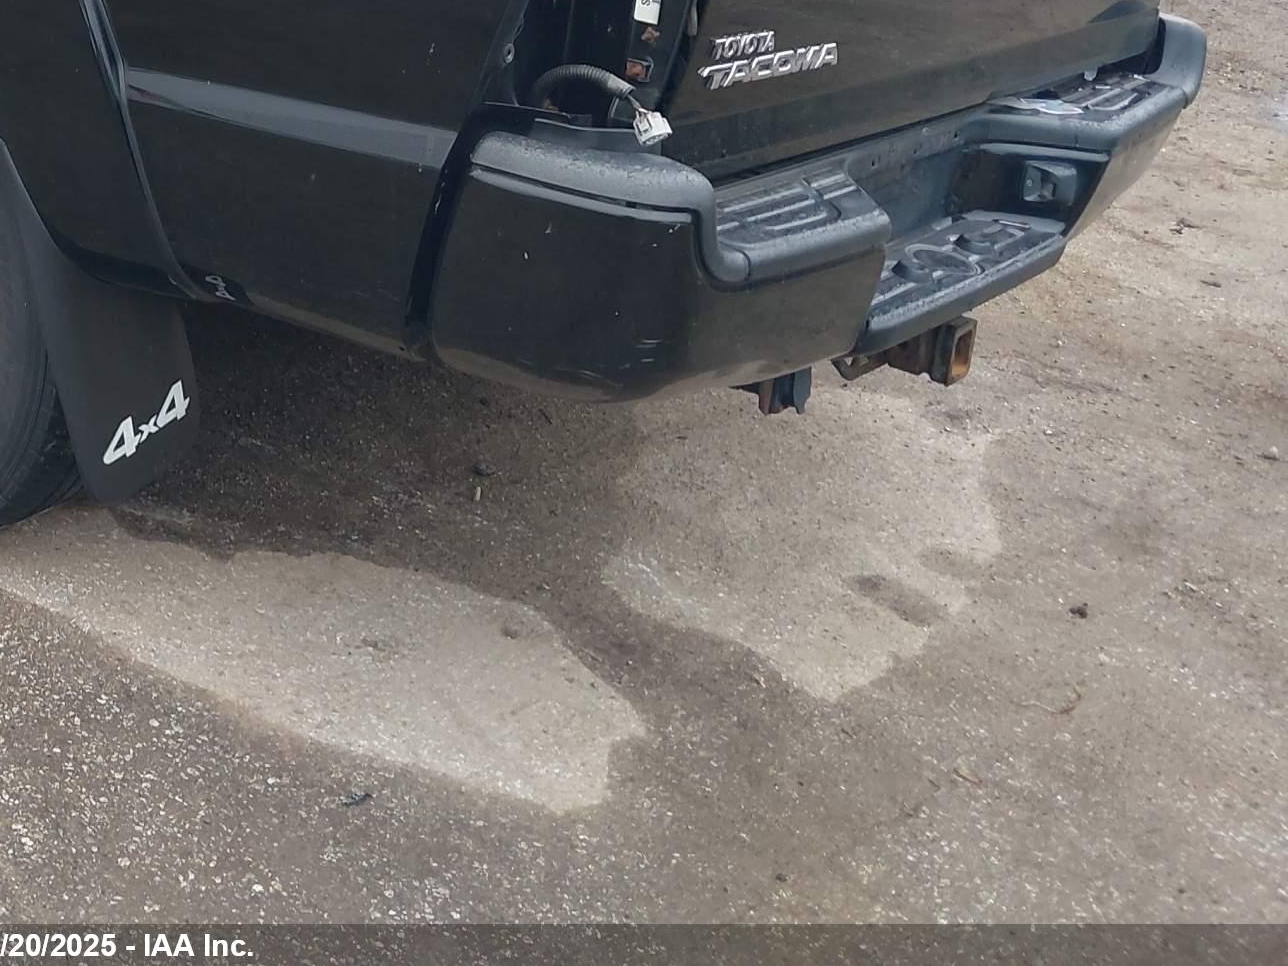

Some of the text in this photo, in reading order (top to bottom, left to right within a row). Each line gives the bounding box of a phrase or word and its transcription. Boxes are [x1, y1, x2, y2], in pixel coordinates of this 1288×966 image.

[697, 42, 838, 90] TACOMA
[711, 29, 775, 60] TOYOTA
[103, 379, 191, 465] 4x4
